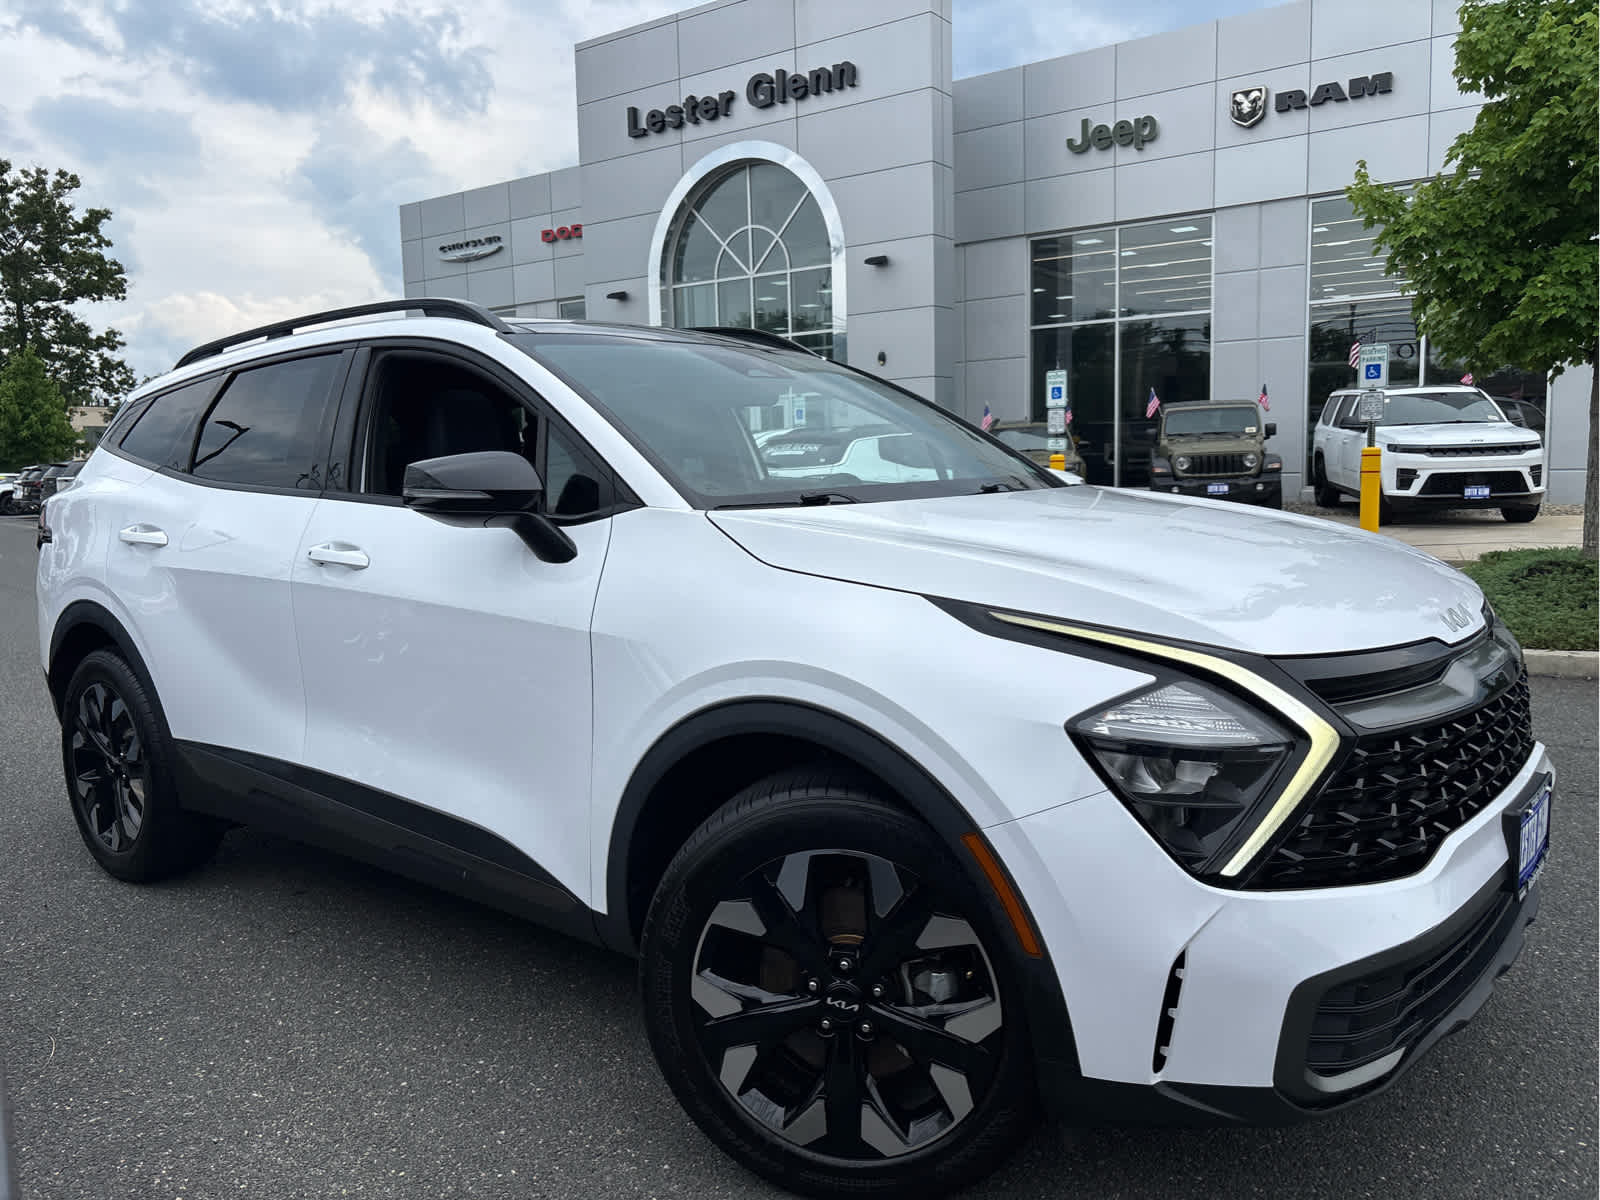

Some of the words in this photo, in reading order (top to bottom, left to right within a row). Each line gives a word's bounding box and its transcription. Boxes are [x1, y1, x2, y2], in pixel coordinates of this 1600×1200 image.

[626, 90, 736, 139] Lester
[746, 61, 857, 109] Glenn
[1274, 72, 1393, 113] RAM
[1066, 115, 1159, 154] Jeep
[439, 235, 503, 253] CHRYSLER
[826, 997, 859, 1012] KIA
